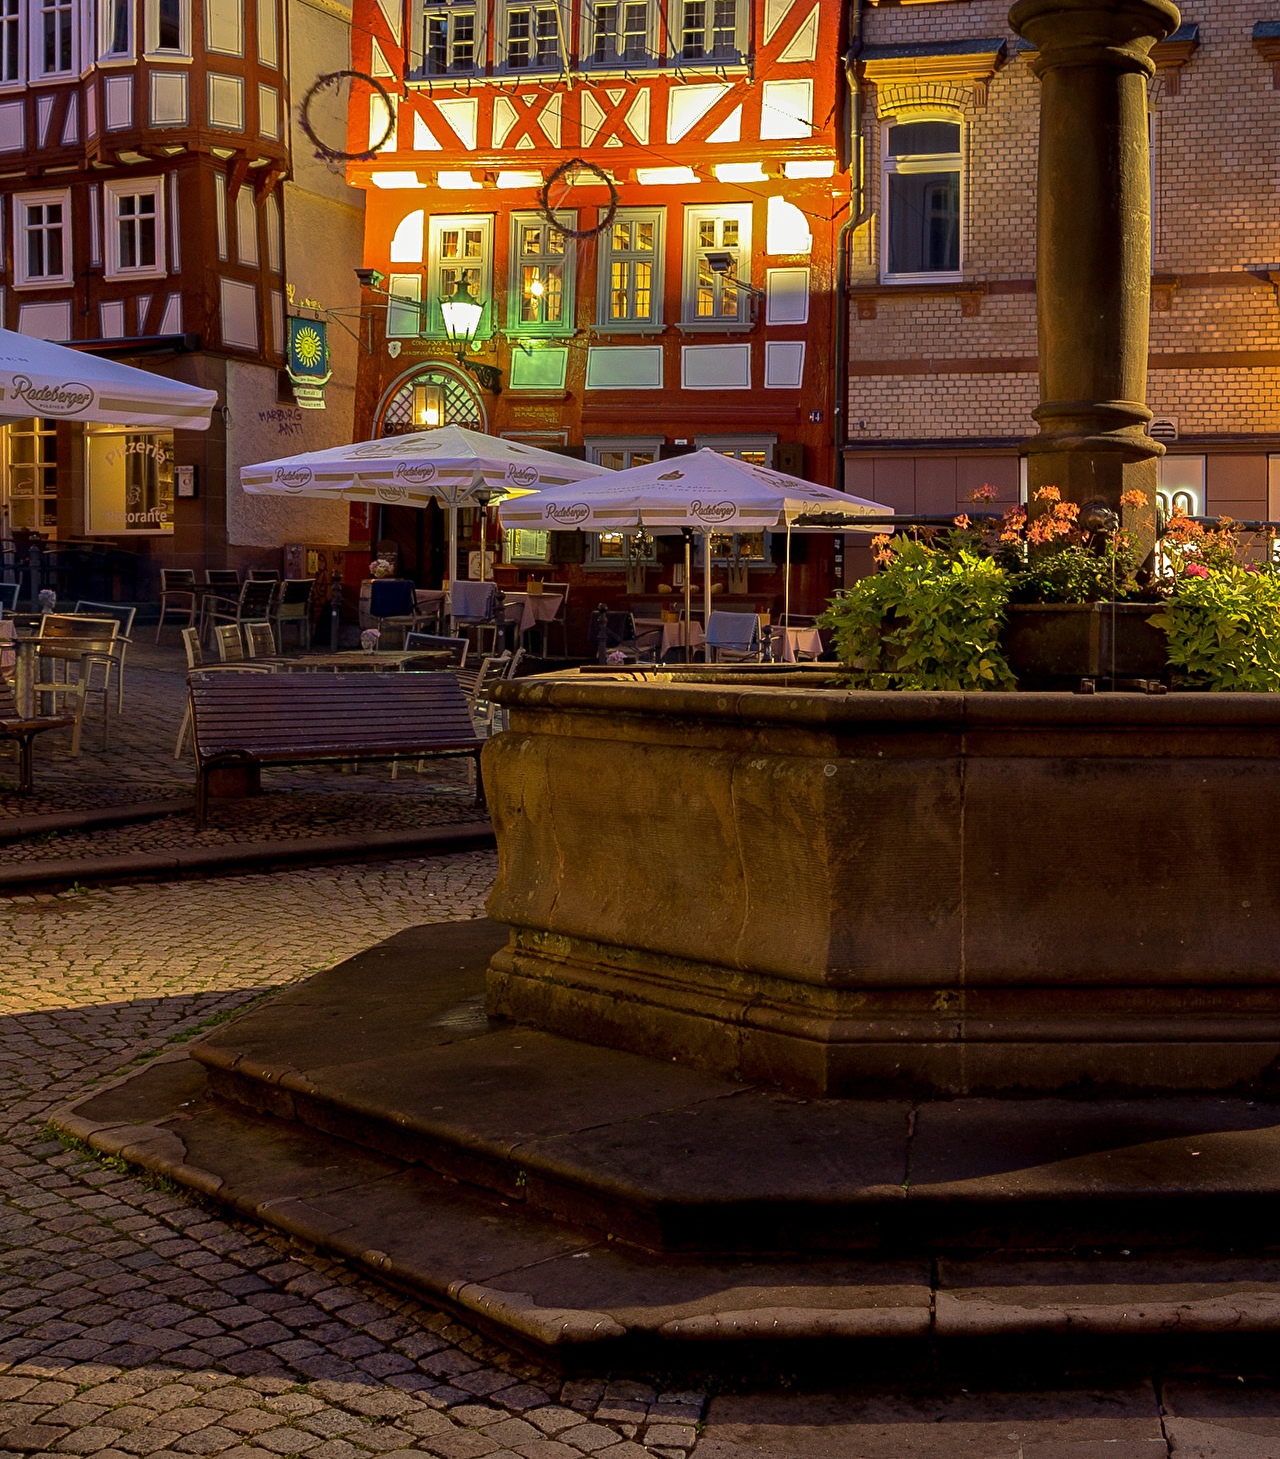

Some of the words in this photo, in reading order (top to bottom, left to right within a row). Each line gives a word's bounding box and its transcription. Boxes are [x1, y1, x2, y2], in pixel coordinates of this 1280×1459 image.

[10, 374, 92, 412] Radeberger
[259, 408, 302, 422] MARBURG
[105, 441, 166, 466] Pizzeria
[545, 502, 590, 522] Radeberger
[690, 499, 736, 521] Radeberger
